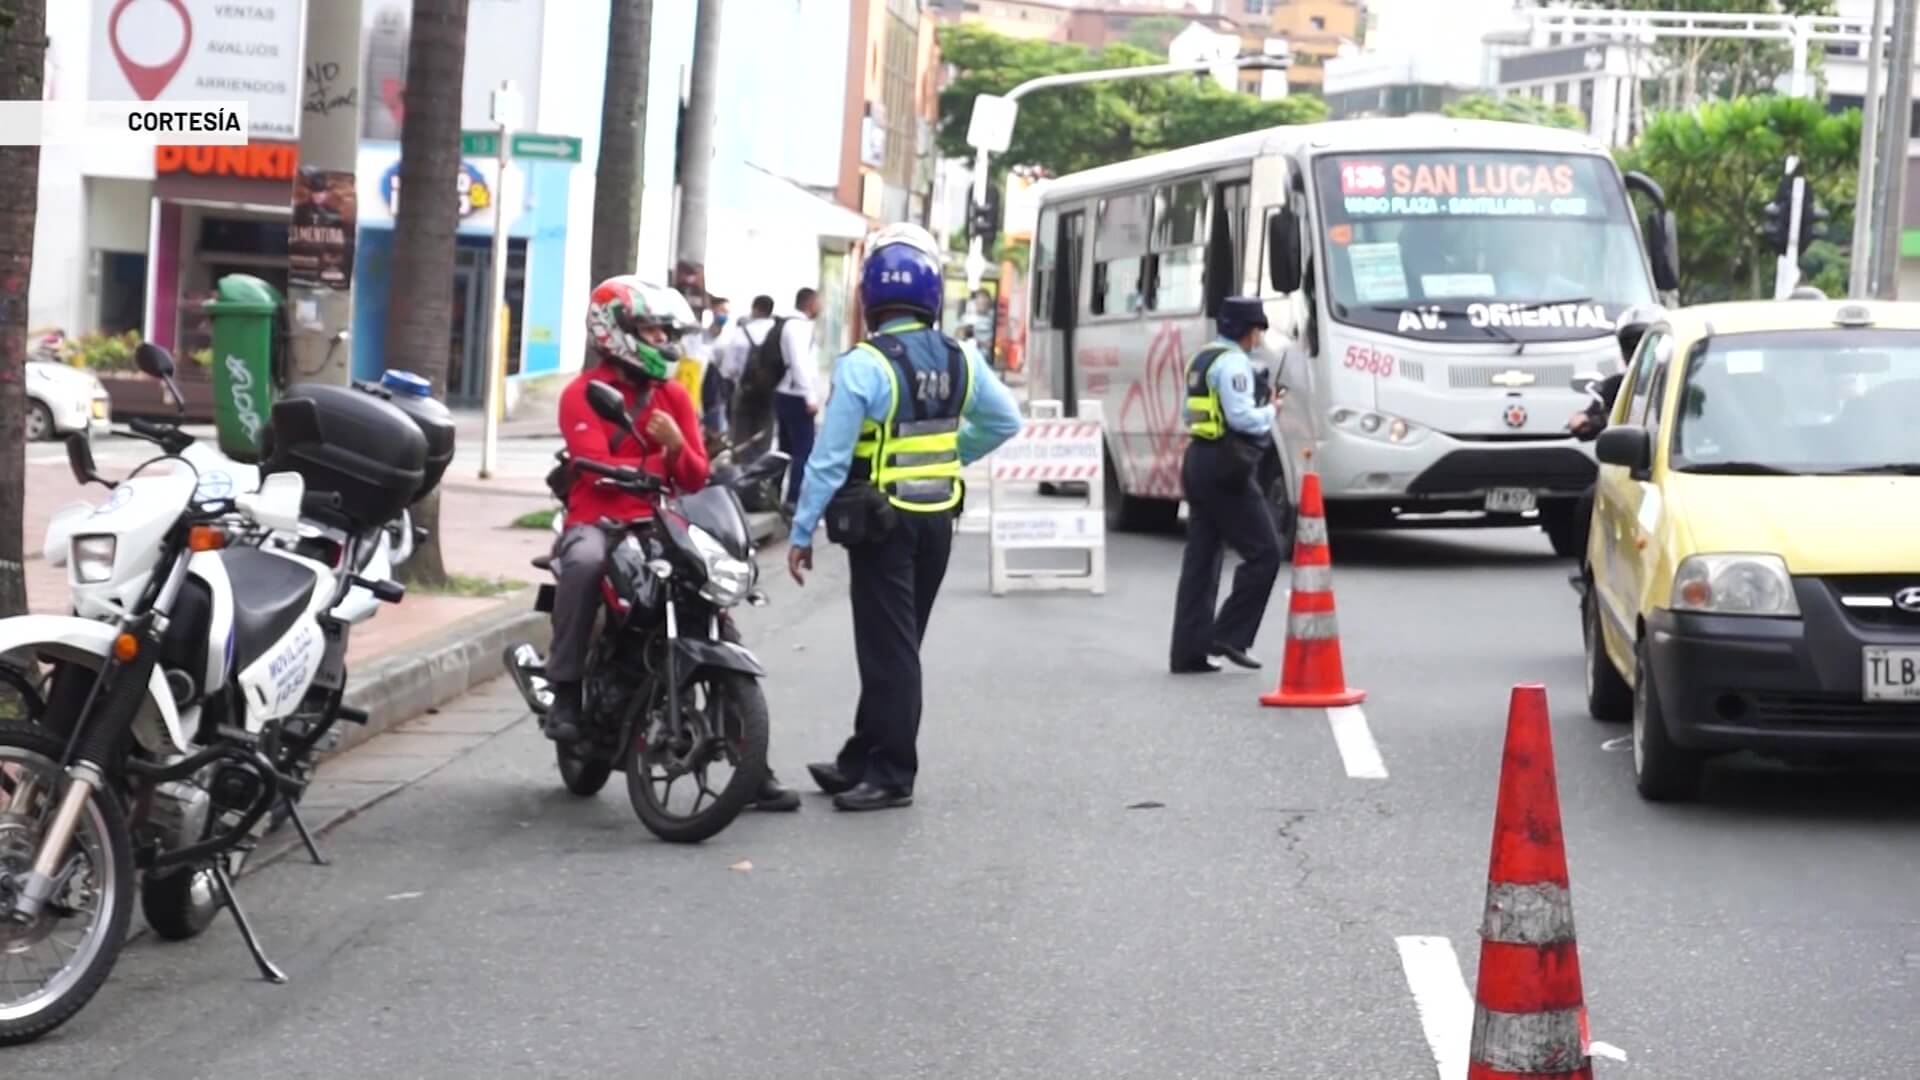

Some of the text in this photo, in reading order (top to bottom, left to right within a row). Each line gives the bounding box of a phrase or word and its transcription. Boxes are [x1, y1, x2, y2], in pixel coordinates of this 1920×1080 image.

[214, 5, 276, 21] VENTAS
[206, 39, 280, 58] AVALUOS
[195, 76, 288, 94] ARRIENDOS
[1392, 163, 1458, 194] SAN
[1467, 164, 1575, 195] LUCAS
[1398, 303, 1617, 331] AV. ORIENTAL
[1343, 346, 1395, 377] 5588
[1869, 656, 1916, 686] TLB
